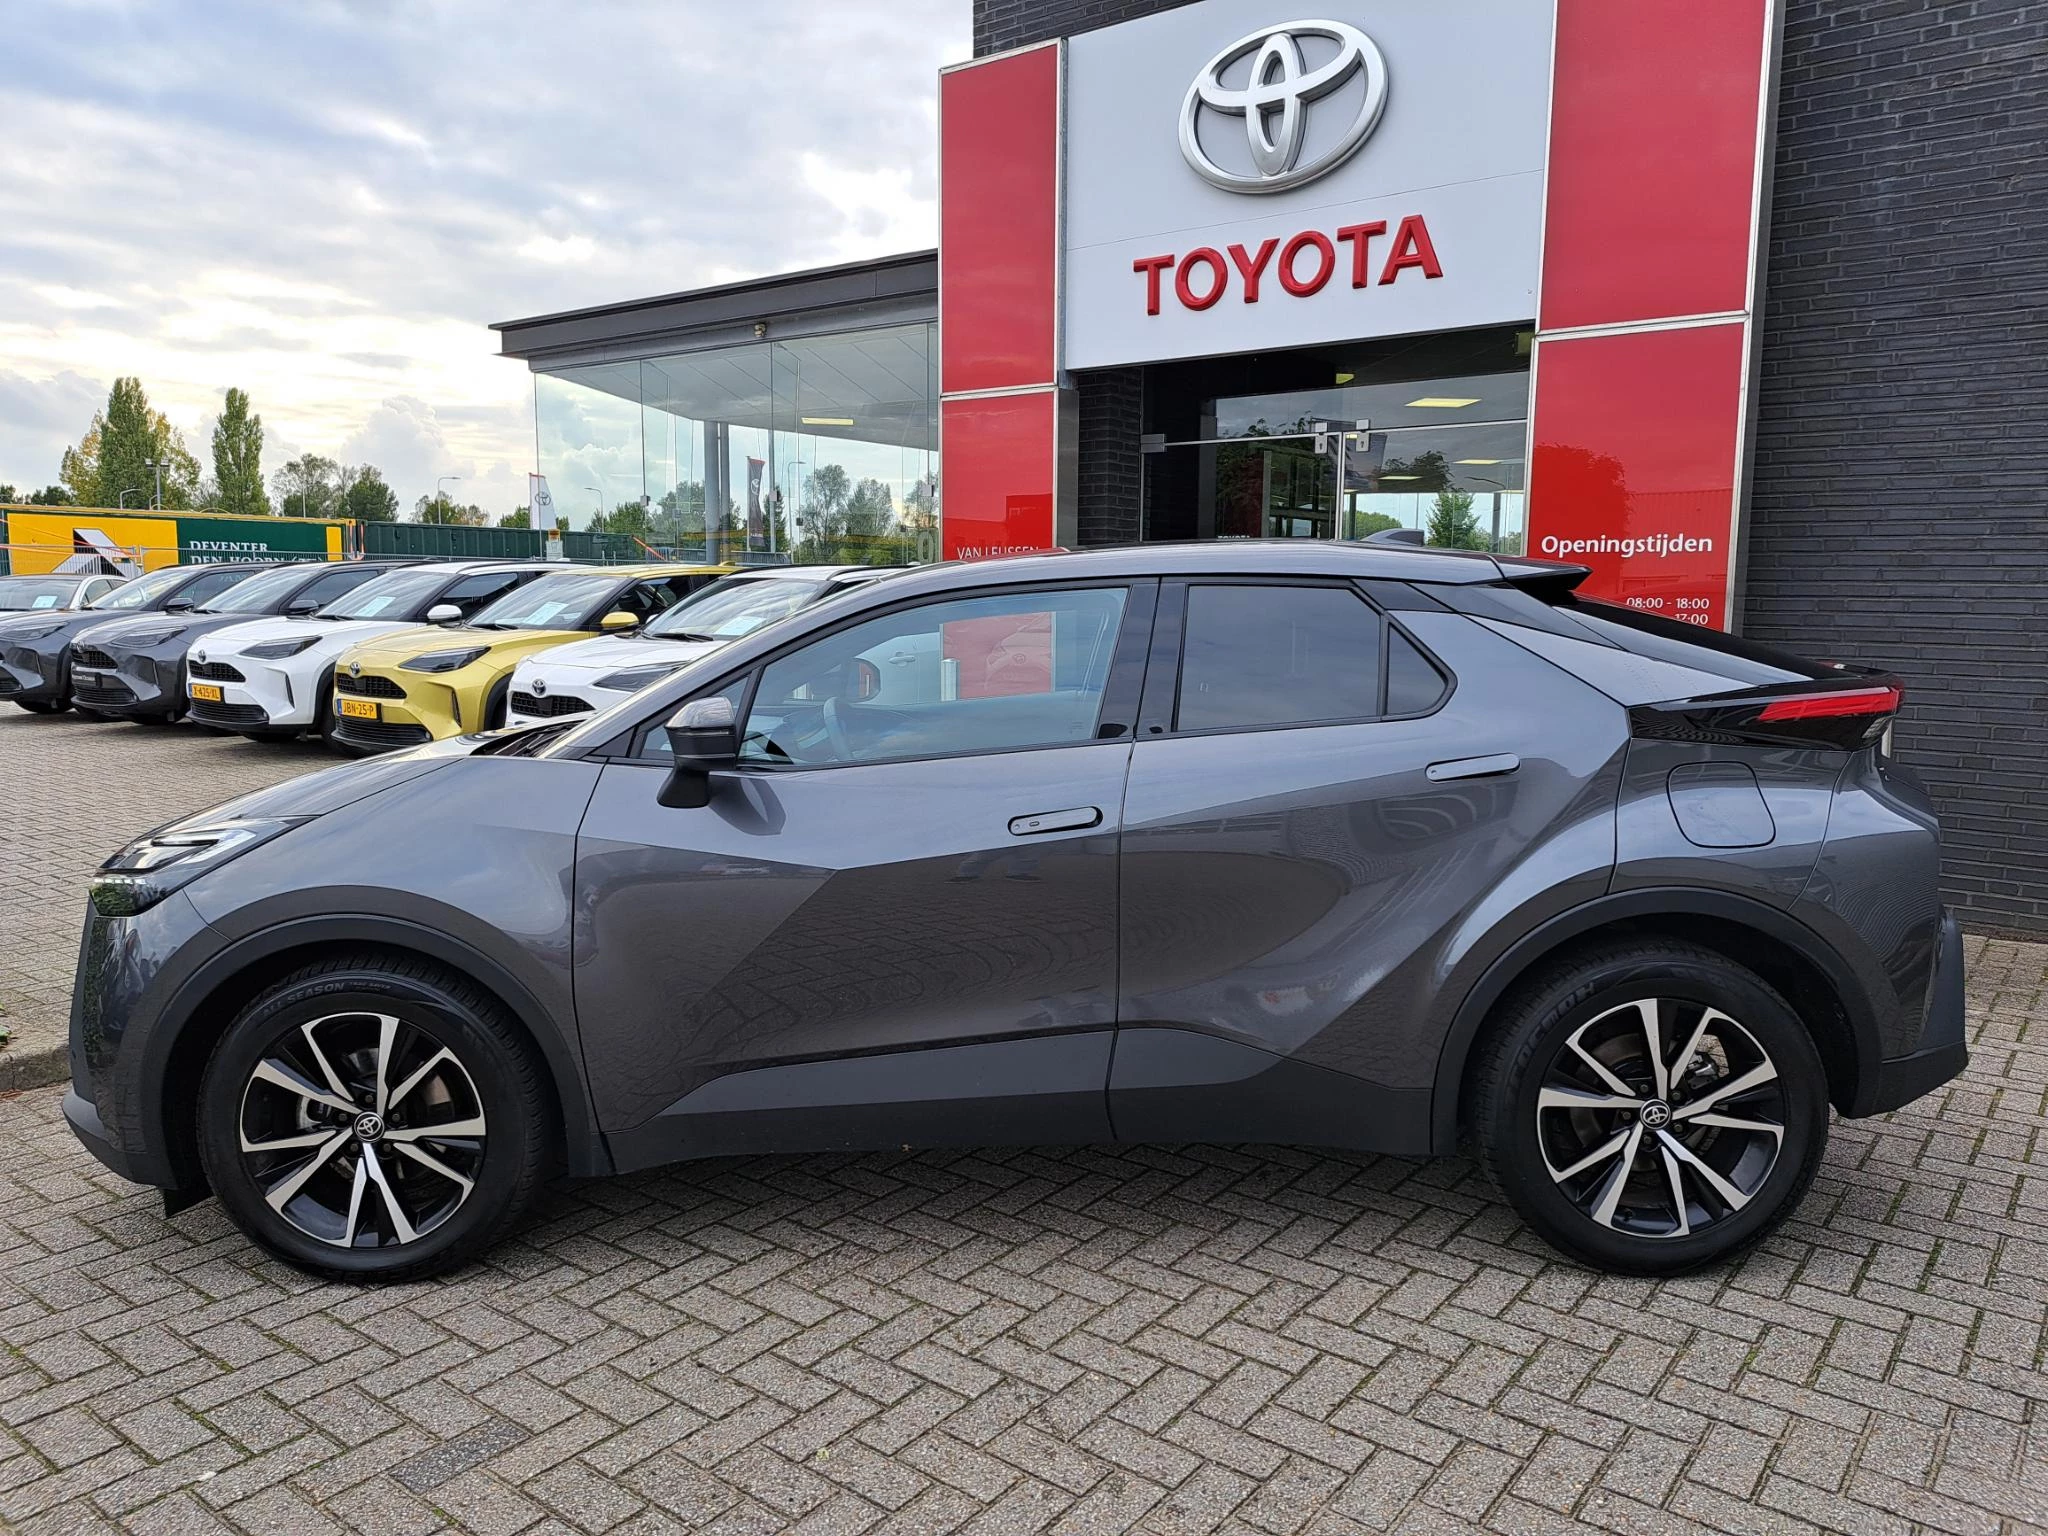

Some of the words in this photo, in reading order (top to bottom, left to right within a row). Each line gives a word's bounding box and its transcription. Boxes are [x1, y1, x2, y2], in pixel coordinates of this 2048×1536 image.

[1133, 214, 1444, 316] TOYOTA
[189, 540, 268, 552] DEVENTER
[957, 546, 982, 560] VAN
[1541, 533, 1712, 558] Openingstijden
[1626, 597, 1664, 609] 08:00
[1675, 597, 1710, 609] 18:00
[343, 701, 374, 717] JBN-25-P
[287, 982, 346, 1001] SEASON
